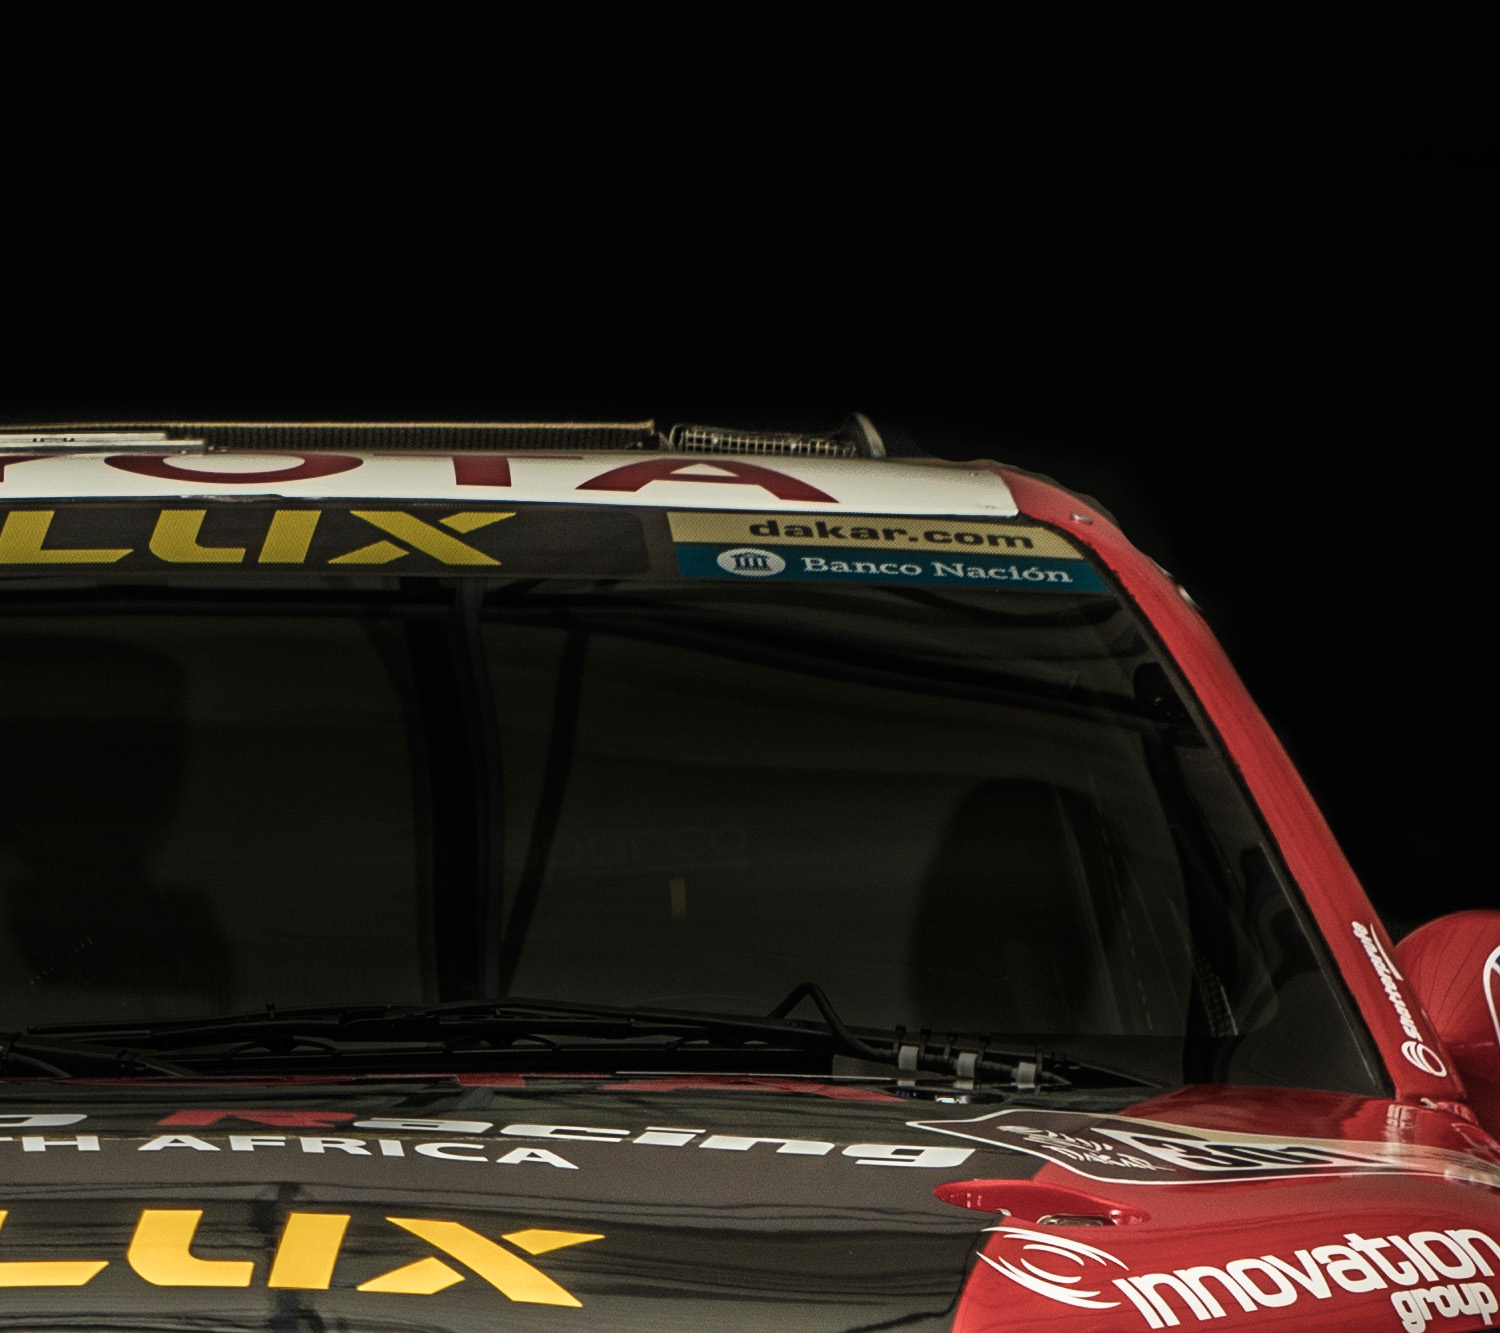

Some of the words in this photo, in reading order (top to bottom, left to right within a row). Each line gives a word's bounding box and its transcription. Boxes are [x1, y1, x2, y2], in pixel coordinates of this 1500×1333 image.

[748, 519, 1034, 549] dakar.com
[801, 556, 922, 578] Banco
[931, 559, 1074, 584] Nación
[137, 1135, 580, 1170] AFRICA
[156, 1110, 977, 1168] Racing
[1130, 1136, 1390, 1167] 301
